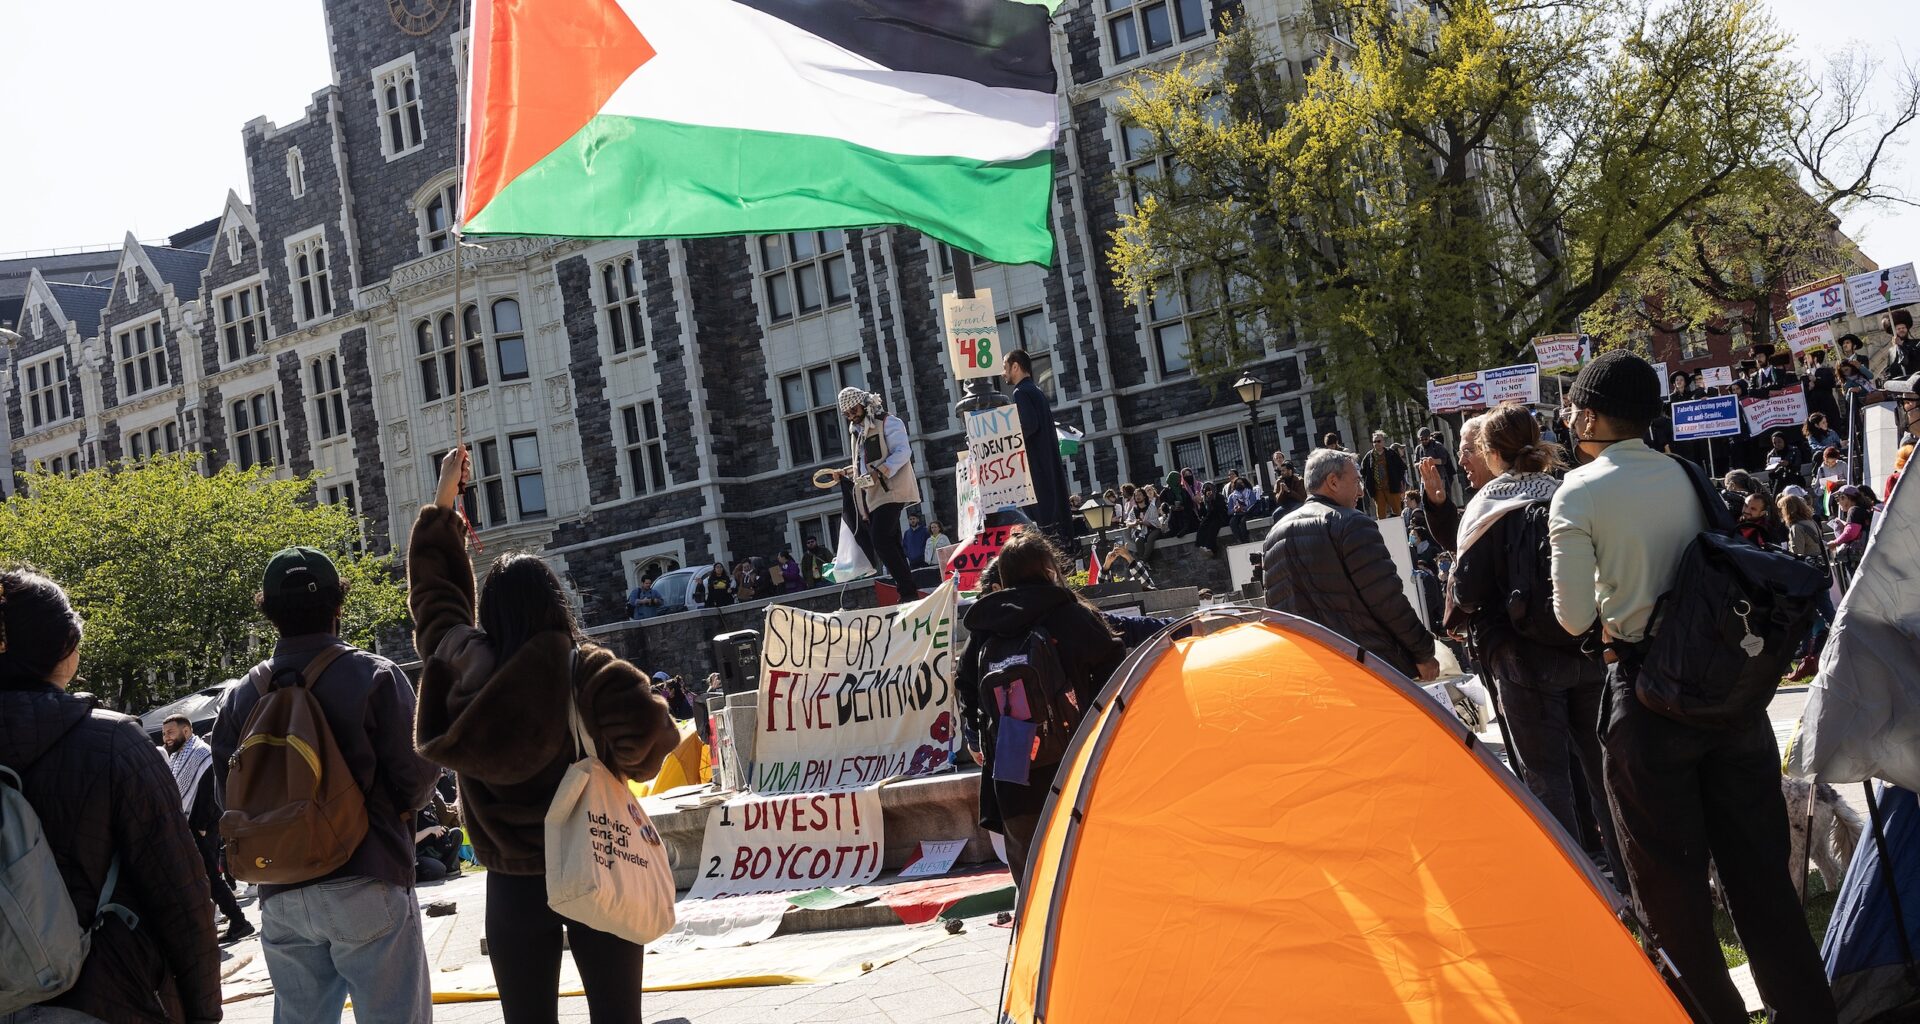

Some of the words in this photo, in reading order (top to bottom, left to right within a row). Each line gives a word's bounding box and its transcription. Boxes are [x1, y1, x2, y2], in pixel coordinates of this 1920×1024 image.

[1548, 344, 1575, 352] PALESTINE
[1492, 390, 1532, 399] Anti-Semitism
[1495, 377, 1527, 385] Anti-Israel
[1677, 404, 1694, 414] Falsely
[1694, 402, 1715, 410] accusing
[1716, 400, 1732, 408] people
[1751, 408, 1772, 421] Ignited
[1753, 403, 1765, 411] The
[1766, 397, 1795, 406] Zionists
[967, 407, 1015, 439] CUNY
[973, 433, 1023, 460] STUDENTS
[979, 450, 1026, 486] RESIST
[765, 607, 900, 670] SUPPORT
[766, 669, 840, 732] FIVE
[836, 651, 949, 727] DEMANDS
[758, 761, 801, 792] VIVA
[800, 751, 906, 791] PALESTINA
[719, 805, 735, 827] 1.
[744, 791, 860, 835] DIVEST!
[592, 841, 648, 869] underwater
[593, 852, 615, 870] tour
[706, 855, 725, 878] 2.
[730, 841, 879, 881] BOYCOTT!
